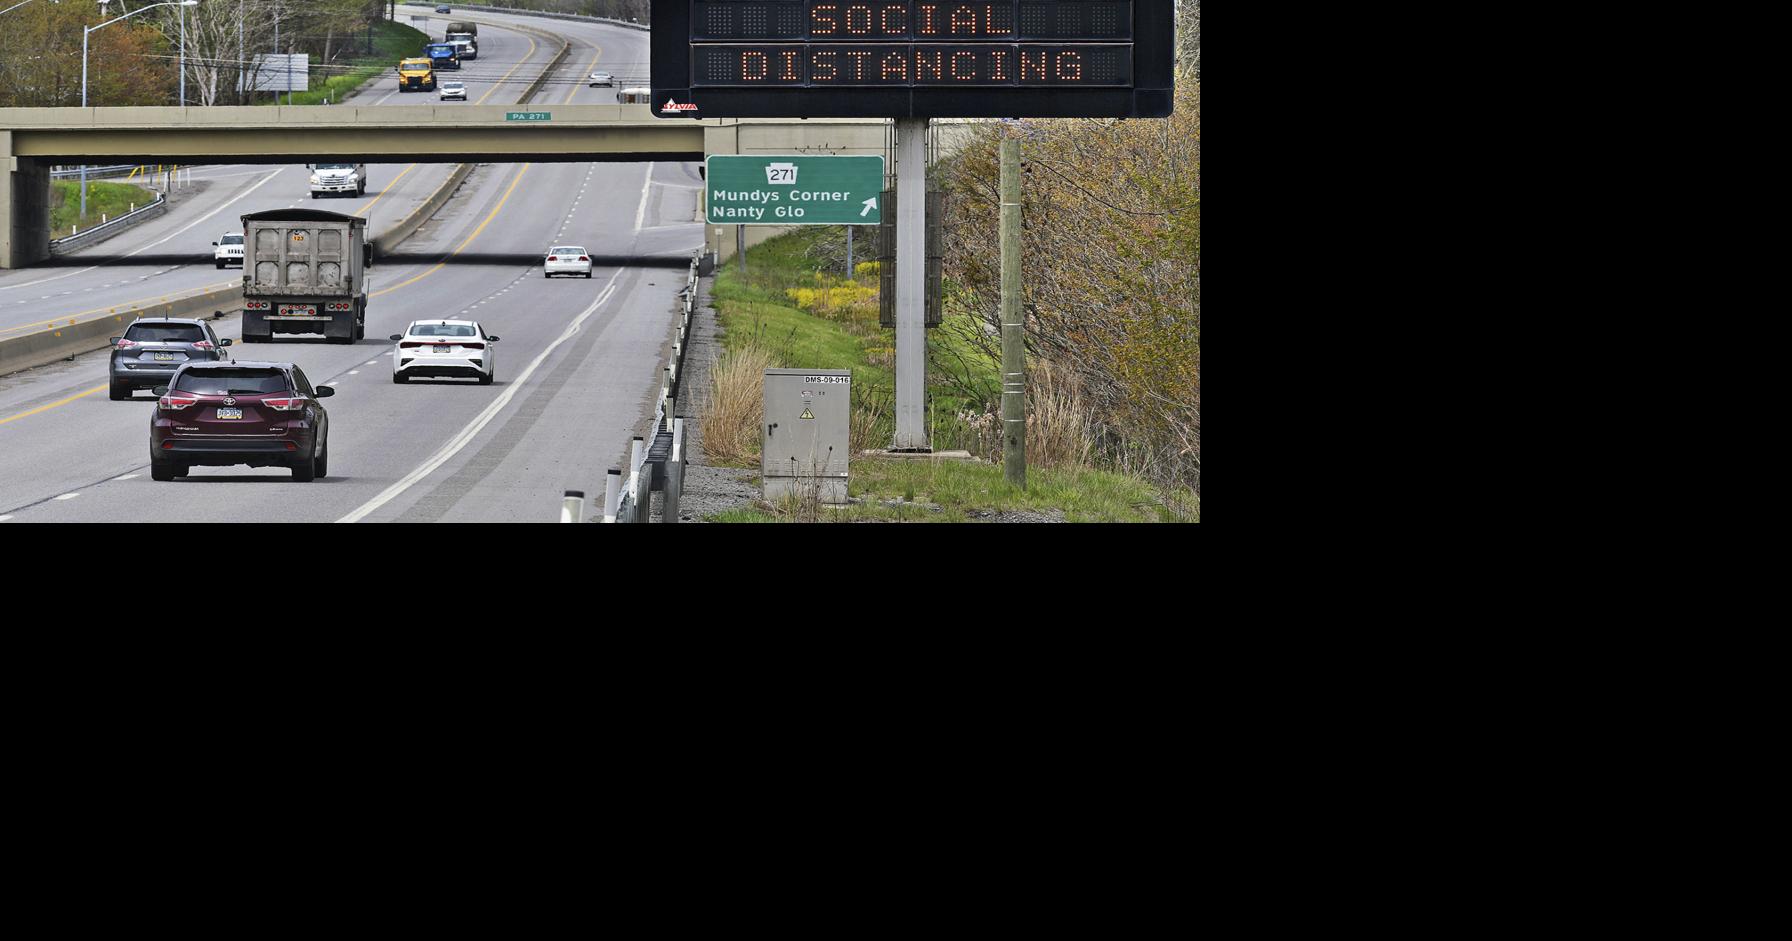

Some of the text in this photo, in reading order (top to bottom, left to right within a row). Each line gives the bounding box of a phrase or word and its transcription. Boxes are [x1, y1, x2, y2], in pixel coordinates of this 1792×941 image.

[812, 5, 1012, 34] SOCIAL
[742, 51, 1081, 80] DISTANCING
[769, 168, 795, 181] 271
[713, 190, 850, 204] Mundys Corner
[712, 206, 805, 220] Nanty Glo
[805, 376, 849, 384] DMS-09-016
